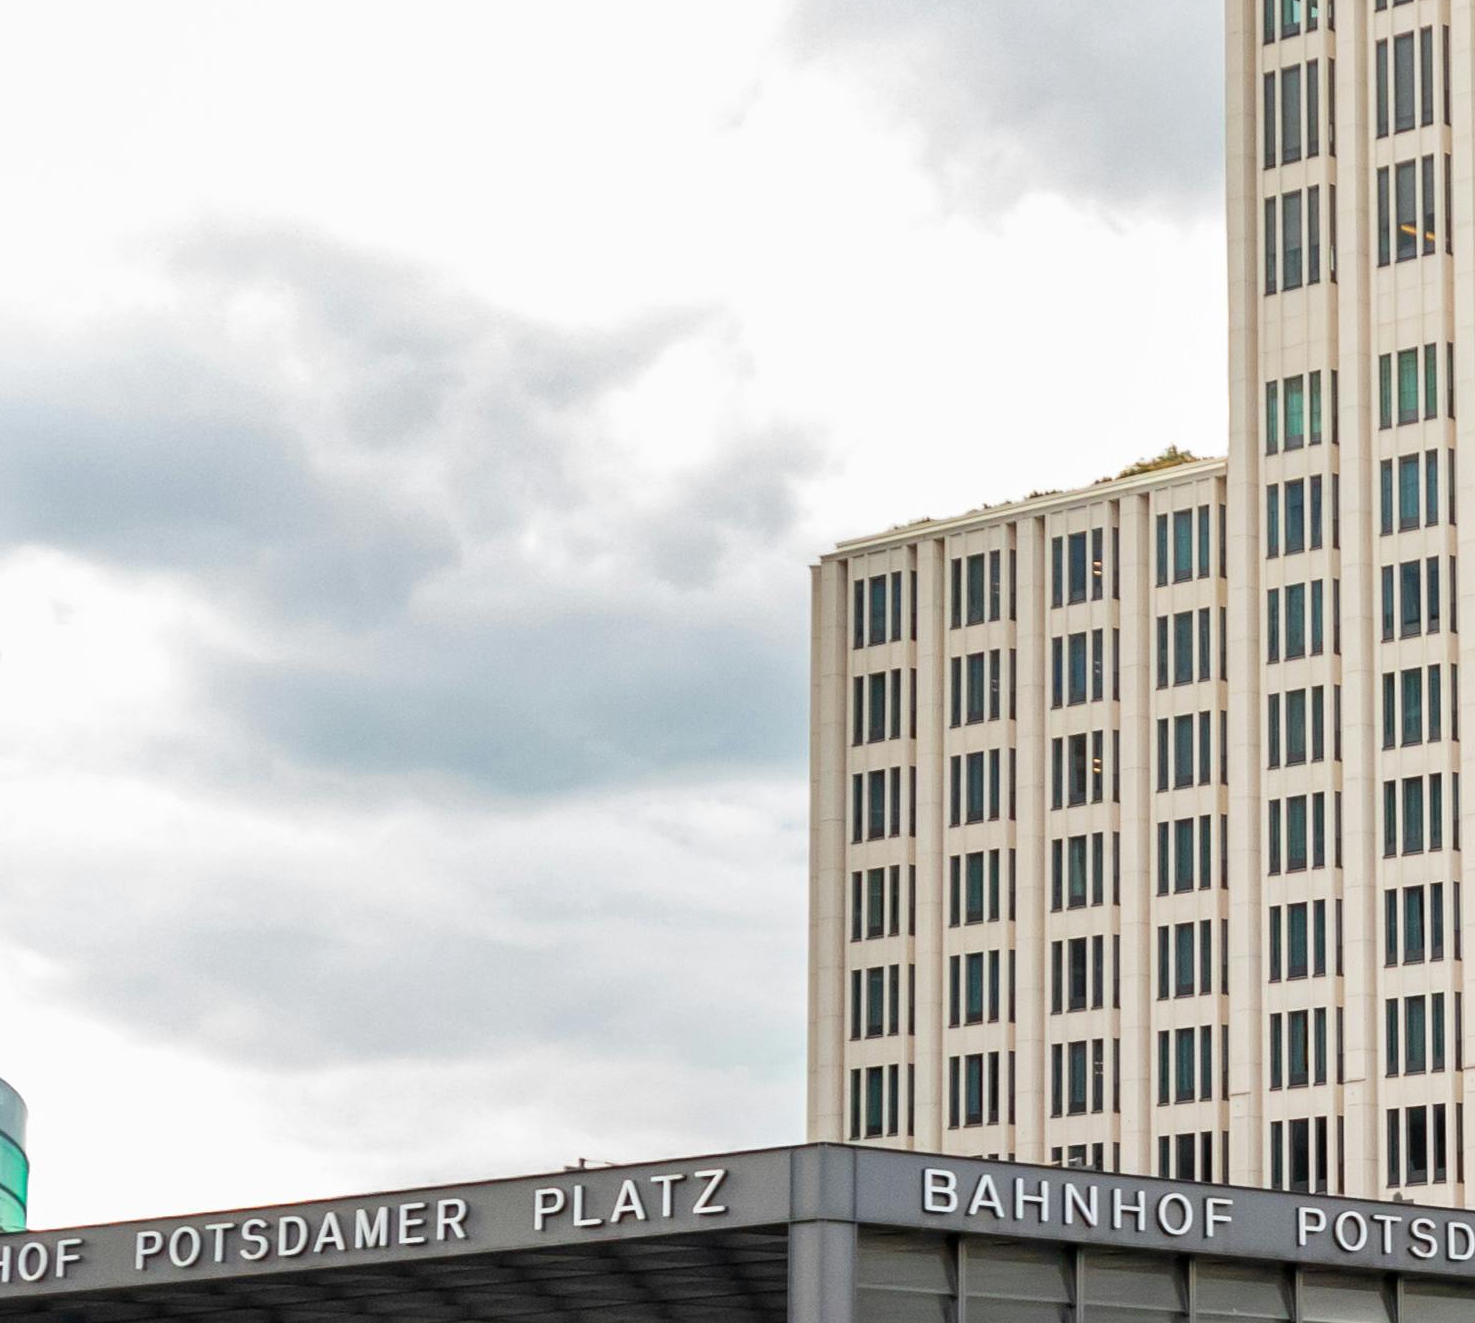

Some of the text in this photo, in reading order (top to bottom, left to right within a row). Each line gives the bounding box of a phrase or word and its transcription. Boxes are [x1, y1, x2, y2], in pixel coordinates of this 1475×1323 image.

[135, 1198, 470, 1271] POTSDAMER
[533, 1168, 729, 1231] PLATZ
[923, 1168, 1234, 1238] BAHNHOF
